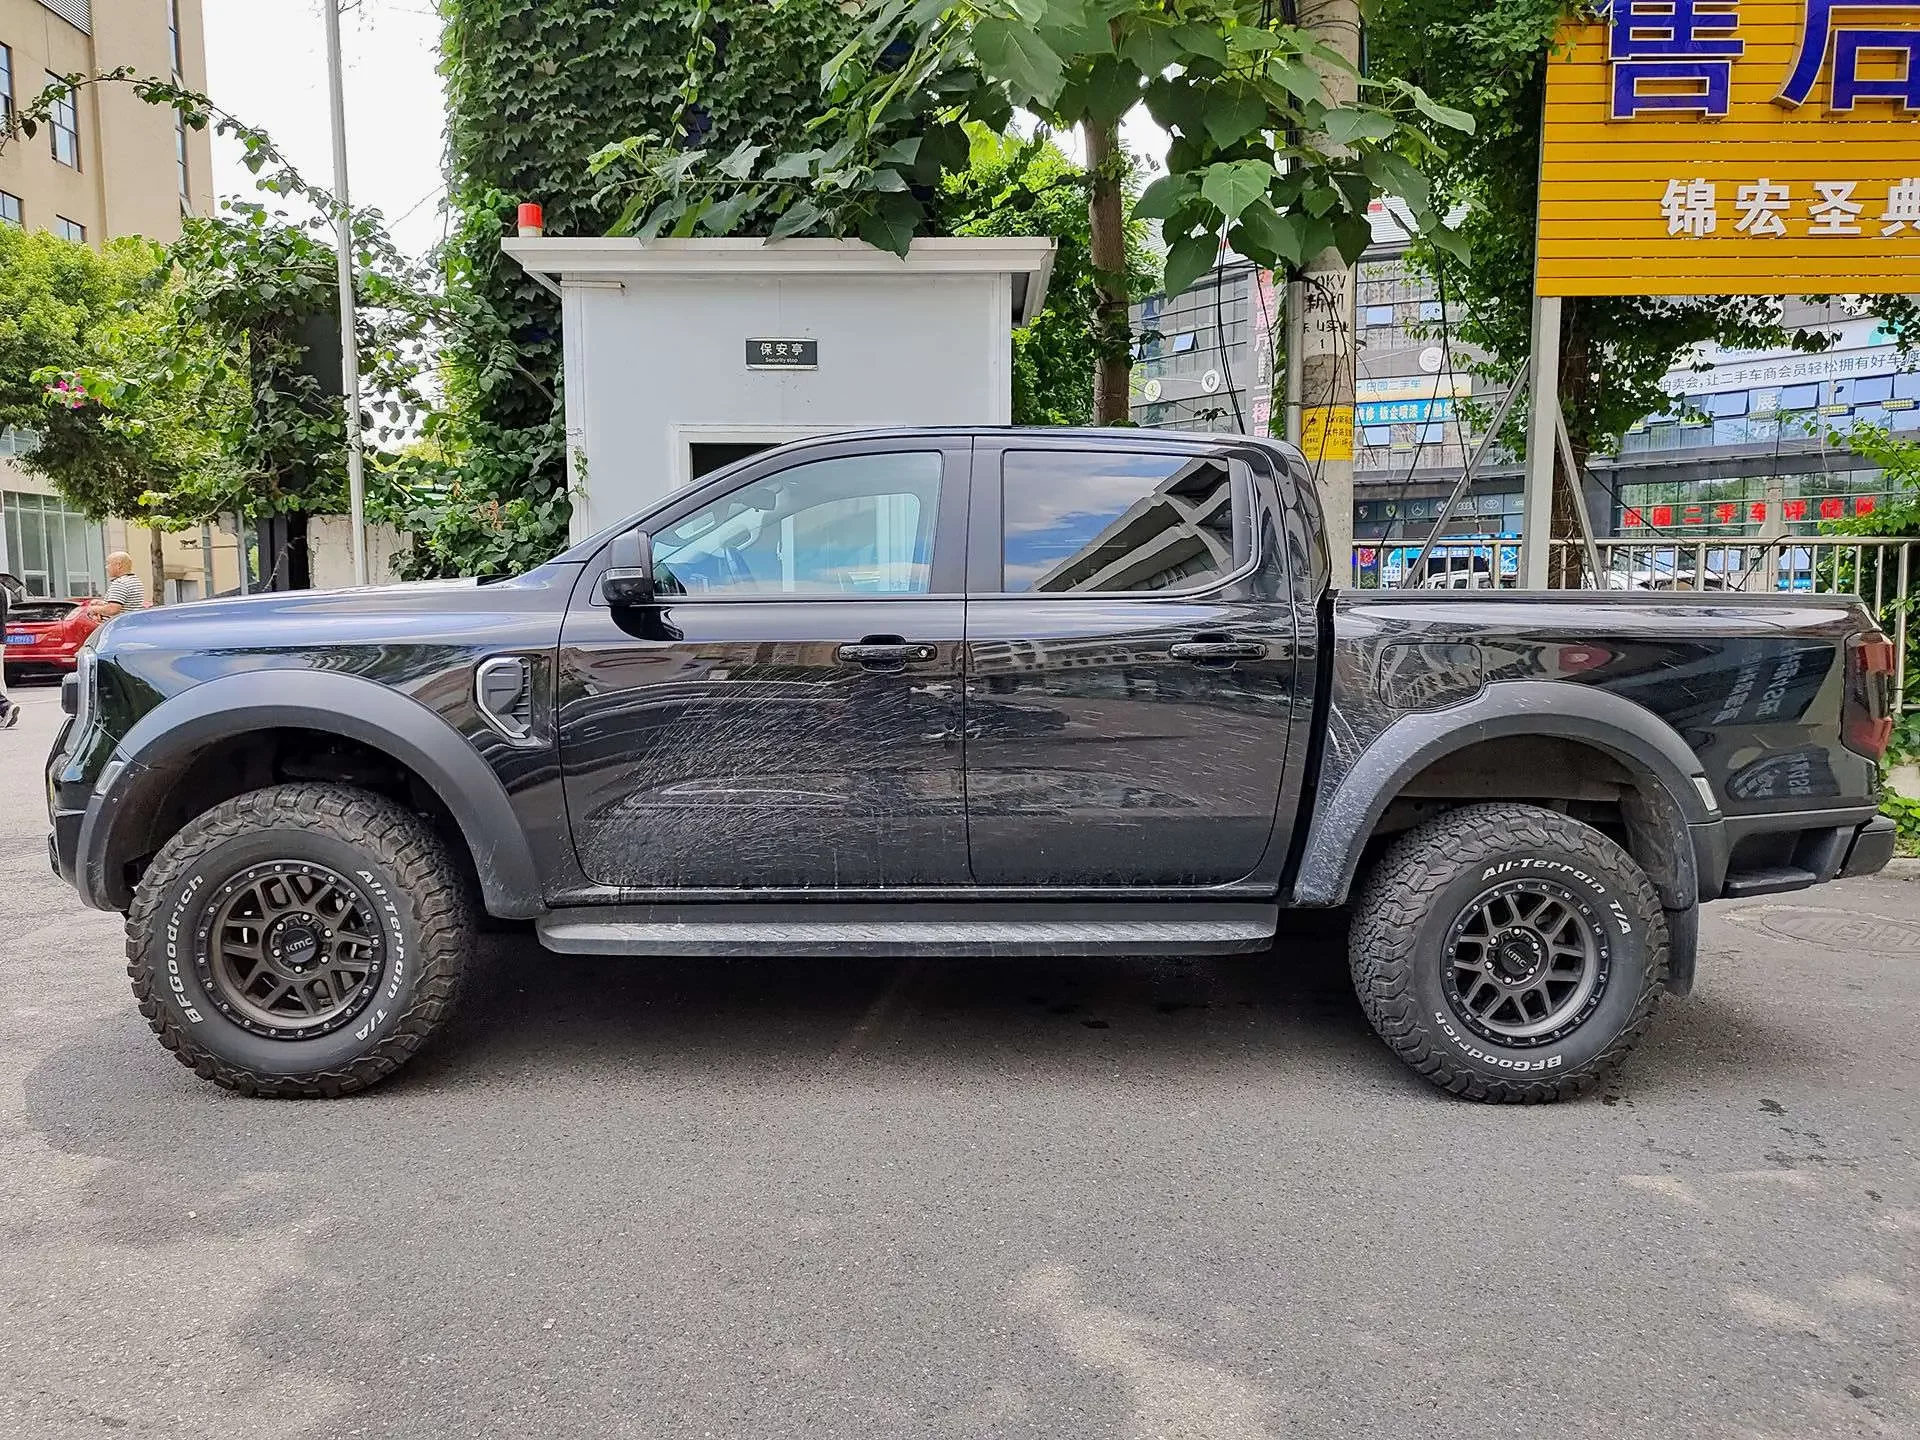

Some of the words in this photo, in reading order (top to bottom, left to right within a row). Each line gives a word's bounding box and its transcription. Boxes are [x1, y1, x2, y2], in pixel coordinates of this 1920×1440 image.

[1608, 0, 1920, 120] 售后
[1660, 178, 1920, 237] 锦宏圣典
[760, 342, 803, 355] 保安亭
[1481, 857, 1606, 895] All-Terrain
[1607, 899, 1632, 935] T/A
[167, 873, 204, 1025] BFGoodrich
[355, 869, 405, 1000] All-Terrain
[354, 1008, 388, 1041] T/A
[1434, 1010, 1563, 1072] BFGoodrich
